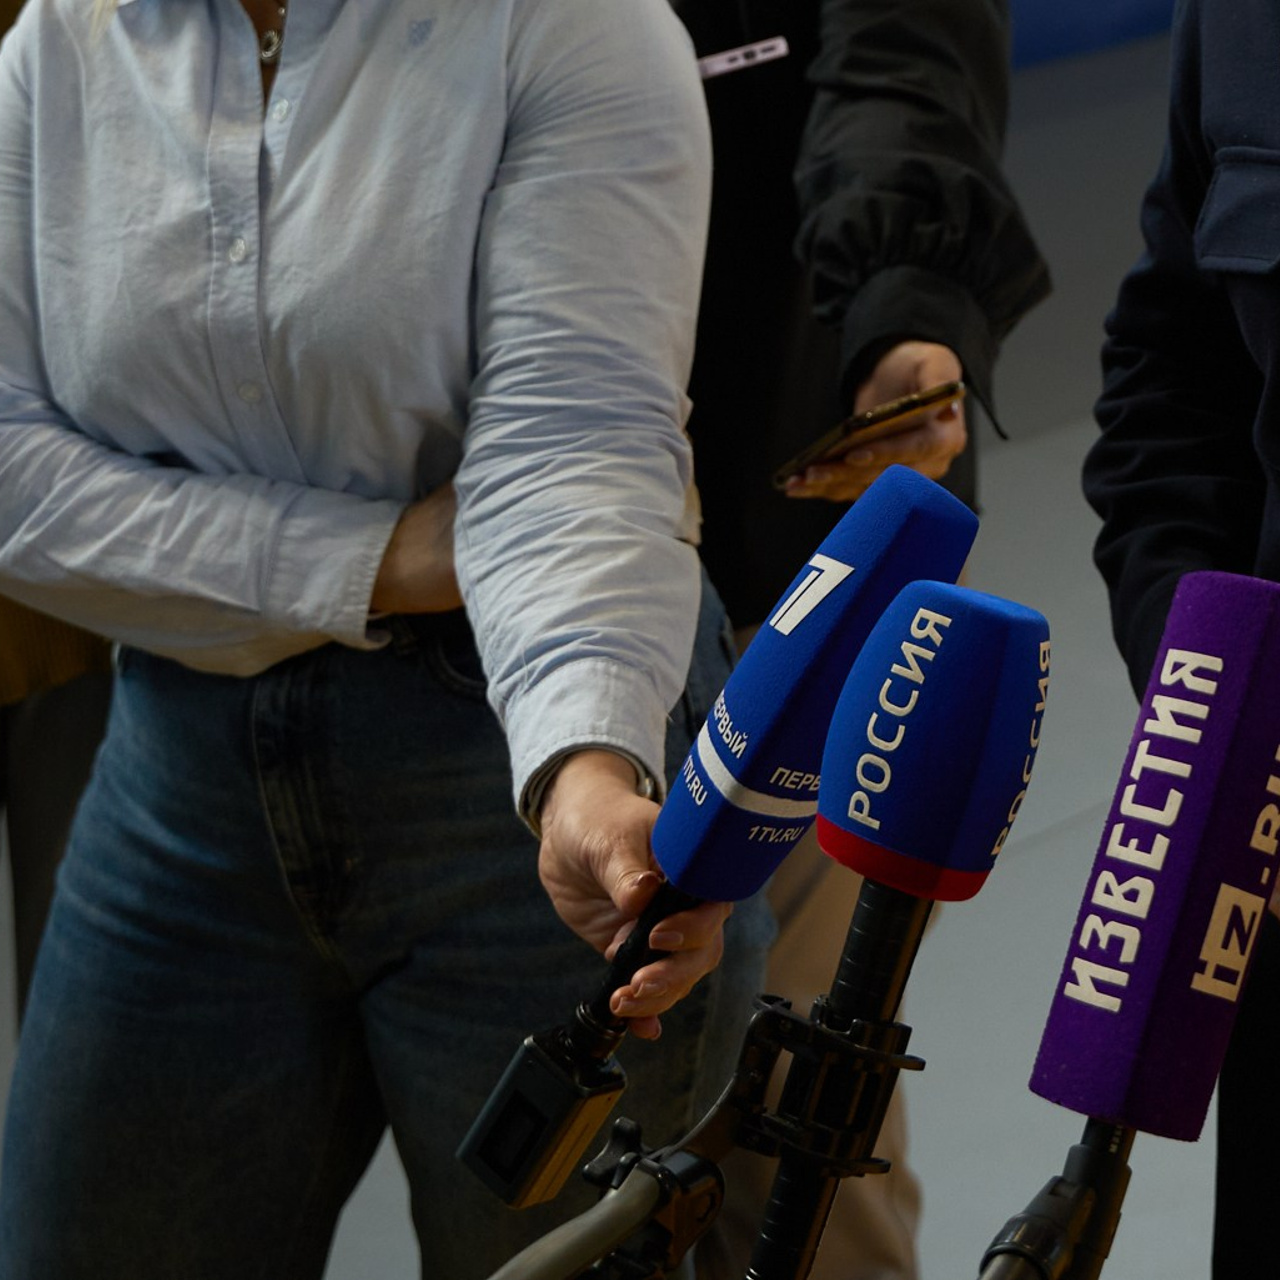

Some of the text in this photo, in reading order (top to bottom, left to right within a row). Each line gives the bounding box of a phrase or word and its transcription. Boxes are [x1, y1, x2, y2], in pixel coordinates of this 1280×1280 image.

[769, 766, 822, 792] ПЕРВ
[849, 607, 952, 830] РОССИЯ
[748, 825, 804, 844] 1TV.RU
[1063, 648, 1224, 1013] ИЗВЕСТИЯ
